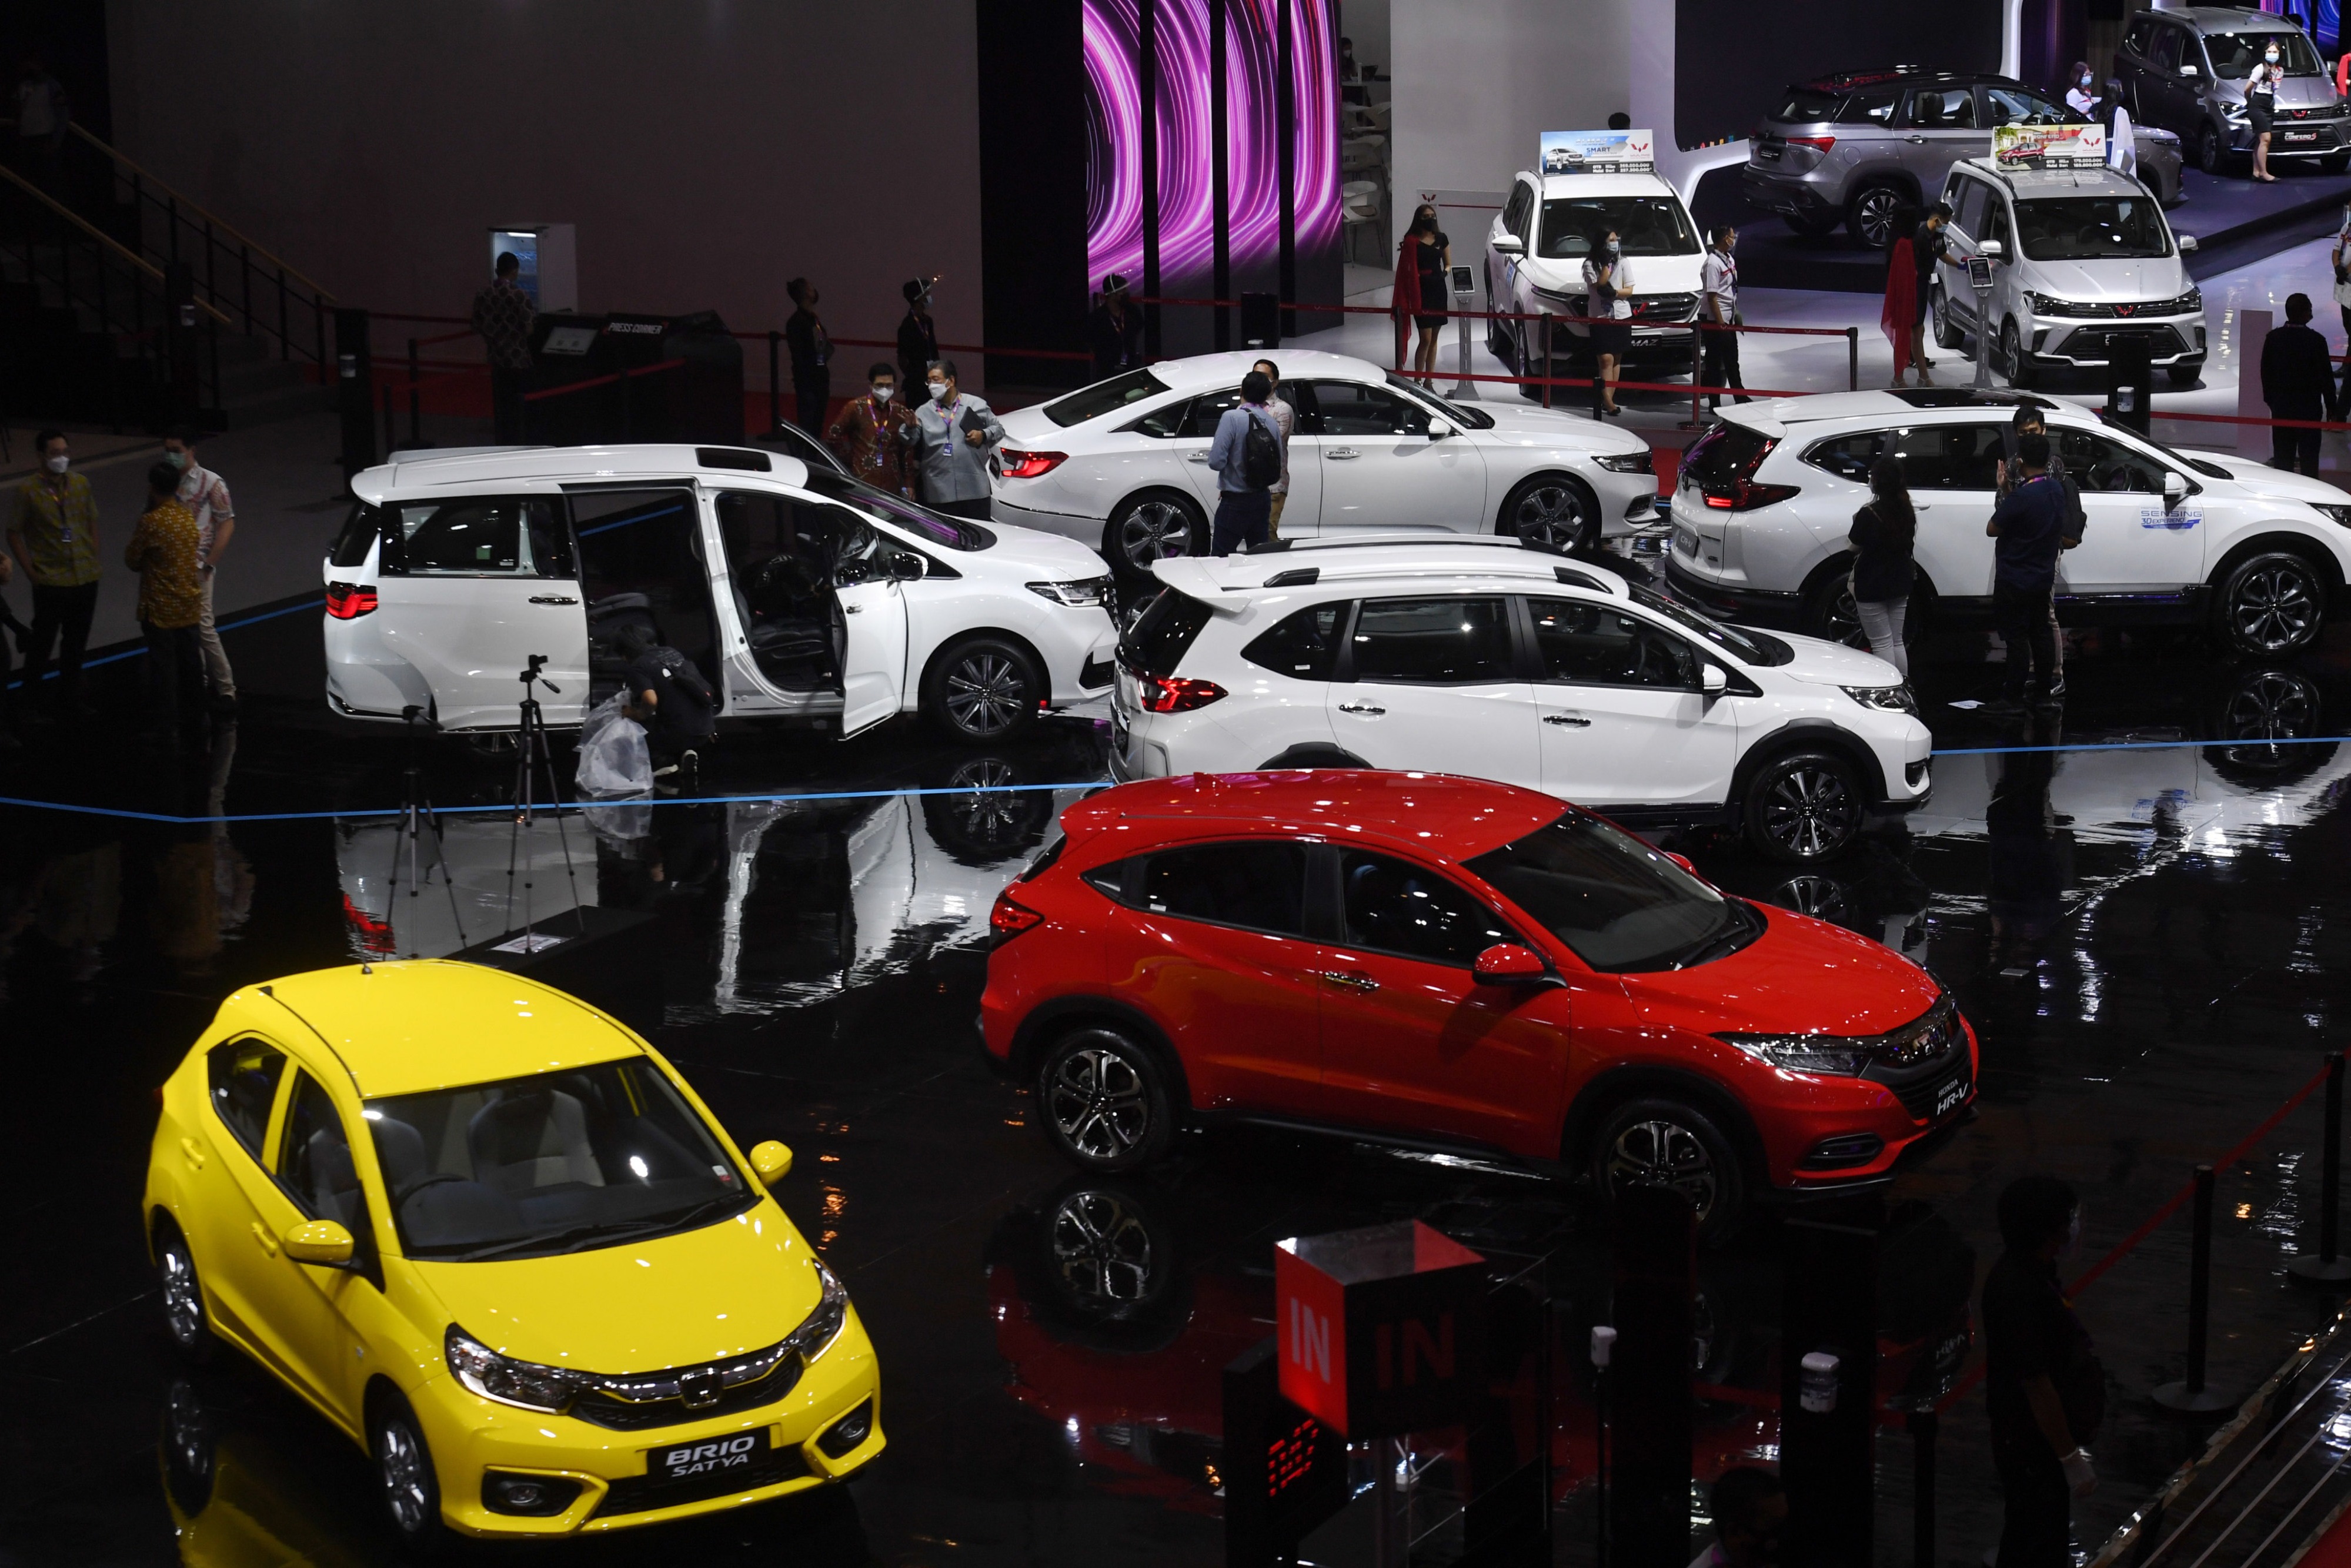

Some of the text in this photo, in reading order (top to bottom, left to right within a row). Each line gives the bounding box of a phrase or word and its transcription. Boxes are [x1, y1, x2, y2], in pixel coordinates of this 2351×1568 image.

[608, 322, 663, 335] PRESS CORNER
[1680, 536, 1693, 548] CR-V
[1936, 1082, 1969, 1116] HR-V
[1938, 1078, 1958, 1098] HONDA
[1290, 1297, 1331, 1385] IN
[1375, 1313, 1455, 1391] IN
[666, 1436, 755, 1466] BRIO
[671, 1454, 749, 1477] SATYA
